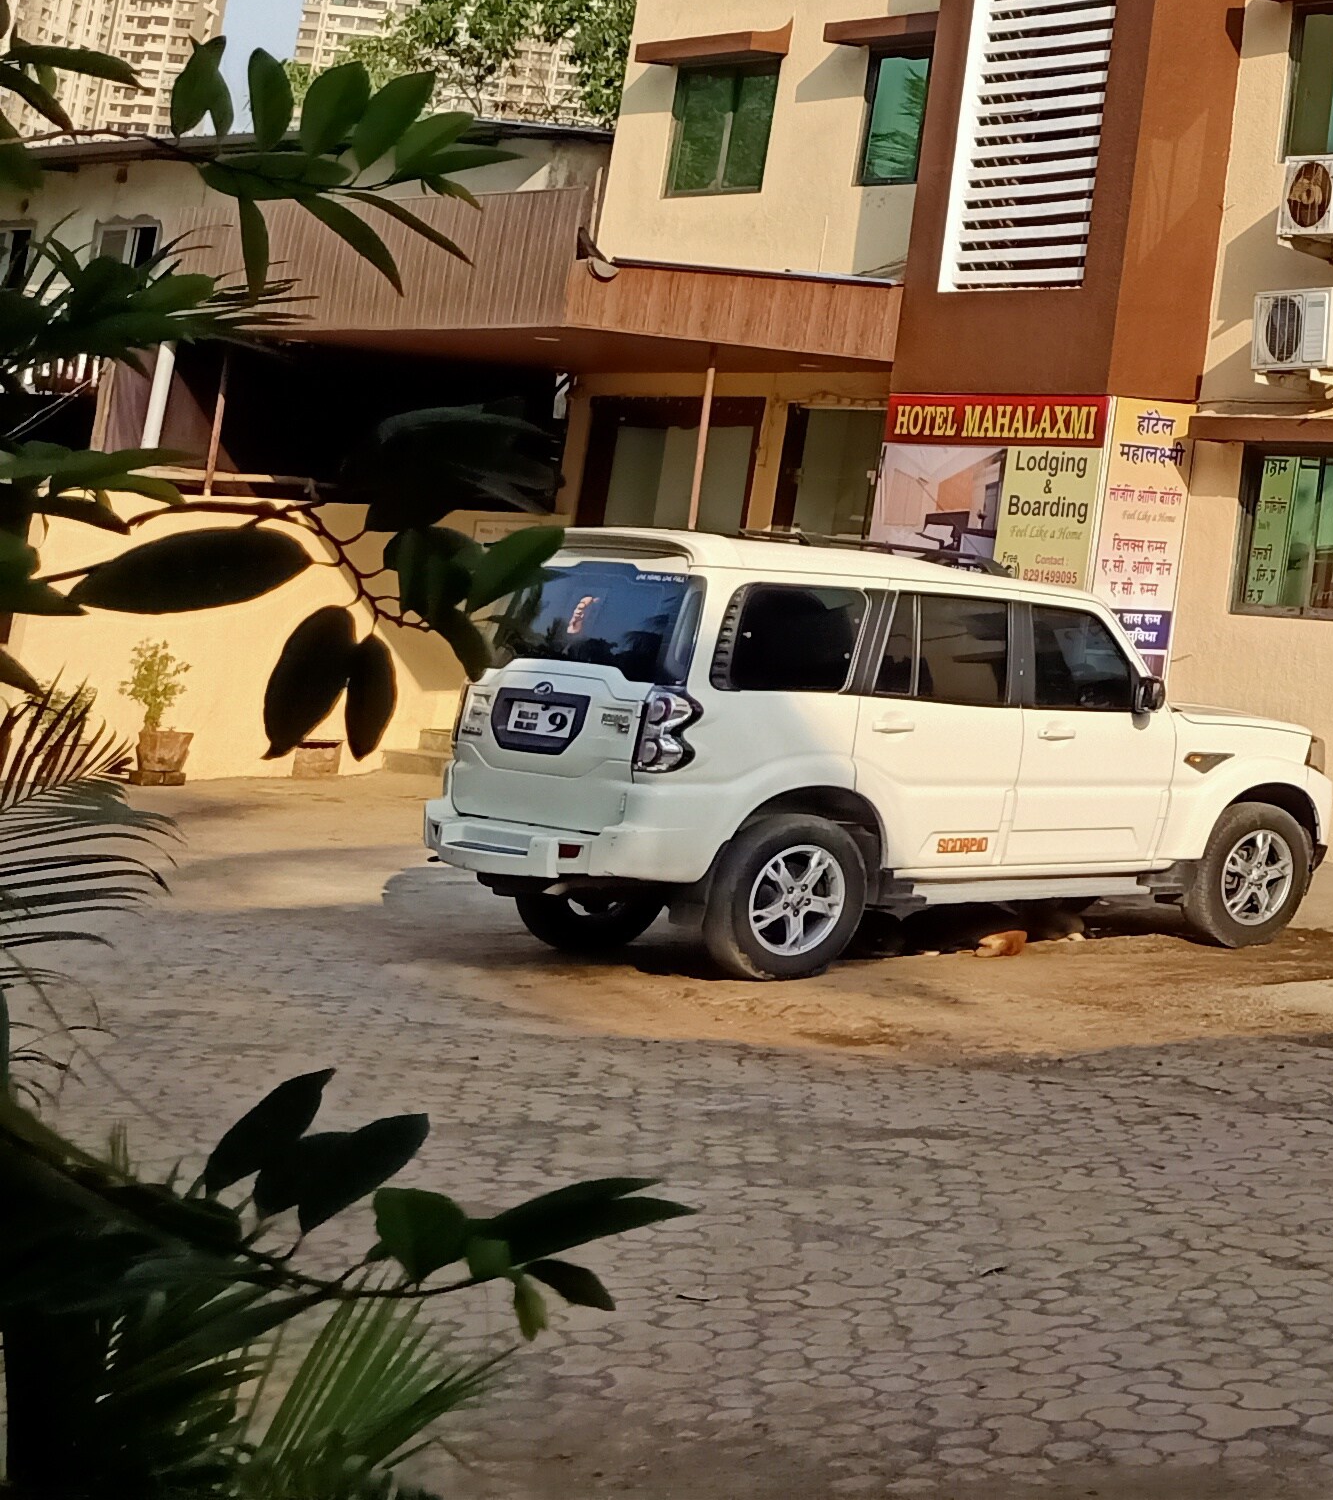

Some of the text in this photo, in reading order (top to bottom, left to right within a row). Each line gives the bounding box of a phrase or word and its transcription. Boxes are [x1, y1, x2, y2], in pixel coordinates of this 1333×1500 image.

[895, 405, 1098, 439] HOTEL MAHALAXMI
[1137, 409, 1176, 436] हॉटेल
[1119, 441, 1186, 468] महालक्ष्मी
[1015, 451, 1089, 478] Lodging
[1043, 480, 1053, 494] &
[1008, 496, 1089, 524] Boarding
[1010, 524, 1027, 538] Feel
[1028, 524, 1049, 541] Like
[1057, 526, 1083, 540] Home
[1002, 552, 1018, 563] Free
[1035, 554, 1065, 566] Contact
[1023, 568, 1078, 585] 8291499095
[936, 837, 989, 854] SCORPIO
